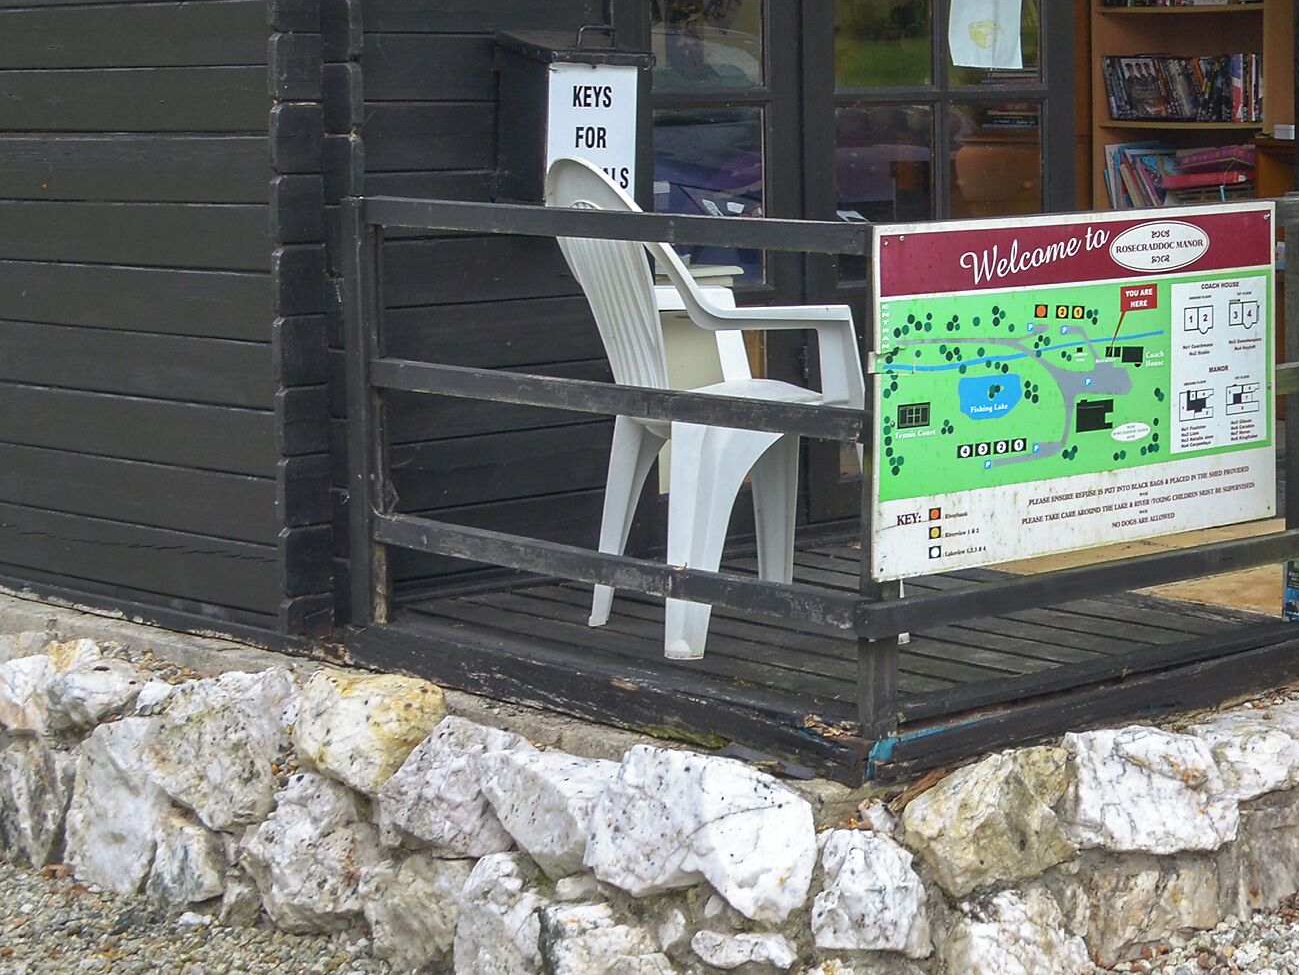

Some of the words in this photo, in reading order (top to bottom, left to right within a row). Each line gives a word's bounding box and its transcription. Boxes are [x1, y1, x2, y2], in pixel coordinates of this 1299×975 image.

[572, 85, 612, 108] KEYS
[575, 126, 607, 149] FOR
[1115, 241, 1175, 254] ROSECRADDOC
[1176, 239, 1204, 249] MANOR
[959, 237, 1082, 285] Welcome
[1085, 226, 1111, 251] to
[1125, 289, 1140, 298] YOU
[1140, 288, 1153, 296] ARE
[1130, 299, 1148, 308] HERE
[1189, 315, 1193, 323] 1
[1203, 314, 1208, 322] 2
[1233, 311, 1238, 319] 3
[1145, 351, 1164, 359] Coach
[1209, 365, 1229, 373] MANOR
[970, 405, 993, 414] Fishing
[994, 403, 1008, 411] Lake
[895, 431, 916, 440] Tennis
[917, 429, 936, 437] Court
[1028, 496, 1050, 506] PLEASE
[1051, 493, 1074, 502] ENSURE
[1075, 490, 1096, 499] REFUSE
[1104, 486, 1115, 494] PUT
[1117, 484, 1131, 492] INTO
[1131, 481, 1149, 490] BLACK
[1149, 479, 1164, 487] BAGS
[1169, 475, 1190, 484] PLACED
[1209, 470, 1222, 478] SHED
[1223, 465, 1249, 475] PROVIDED
[1021, 516, 1044, 525] PLEASE
[1045, 513, 1060, 521] TAKE
[1061, 511, 1076, 519] CARE
[1077, 507, 1101, 516] AROUND
[1102, 504, 1113, 512] THE
[1114, 502, 1128, 510] LAKE
[1134, 499, 1149, 507] RIVER
[1172, 491, 1198, 501] CHILDREN
[896, 512, 921, 526] KEY:
[1121, 518, 1137, 526] DOGS
[1138, 516, 1149, 524] ARE
[1150, 512, 1175, 522] ALLOWED
